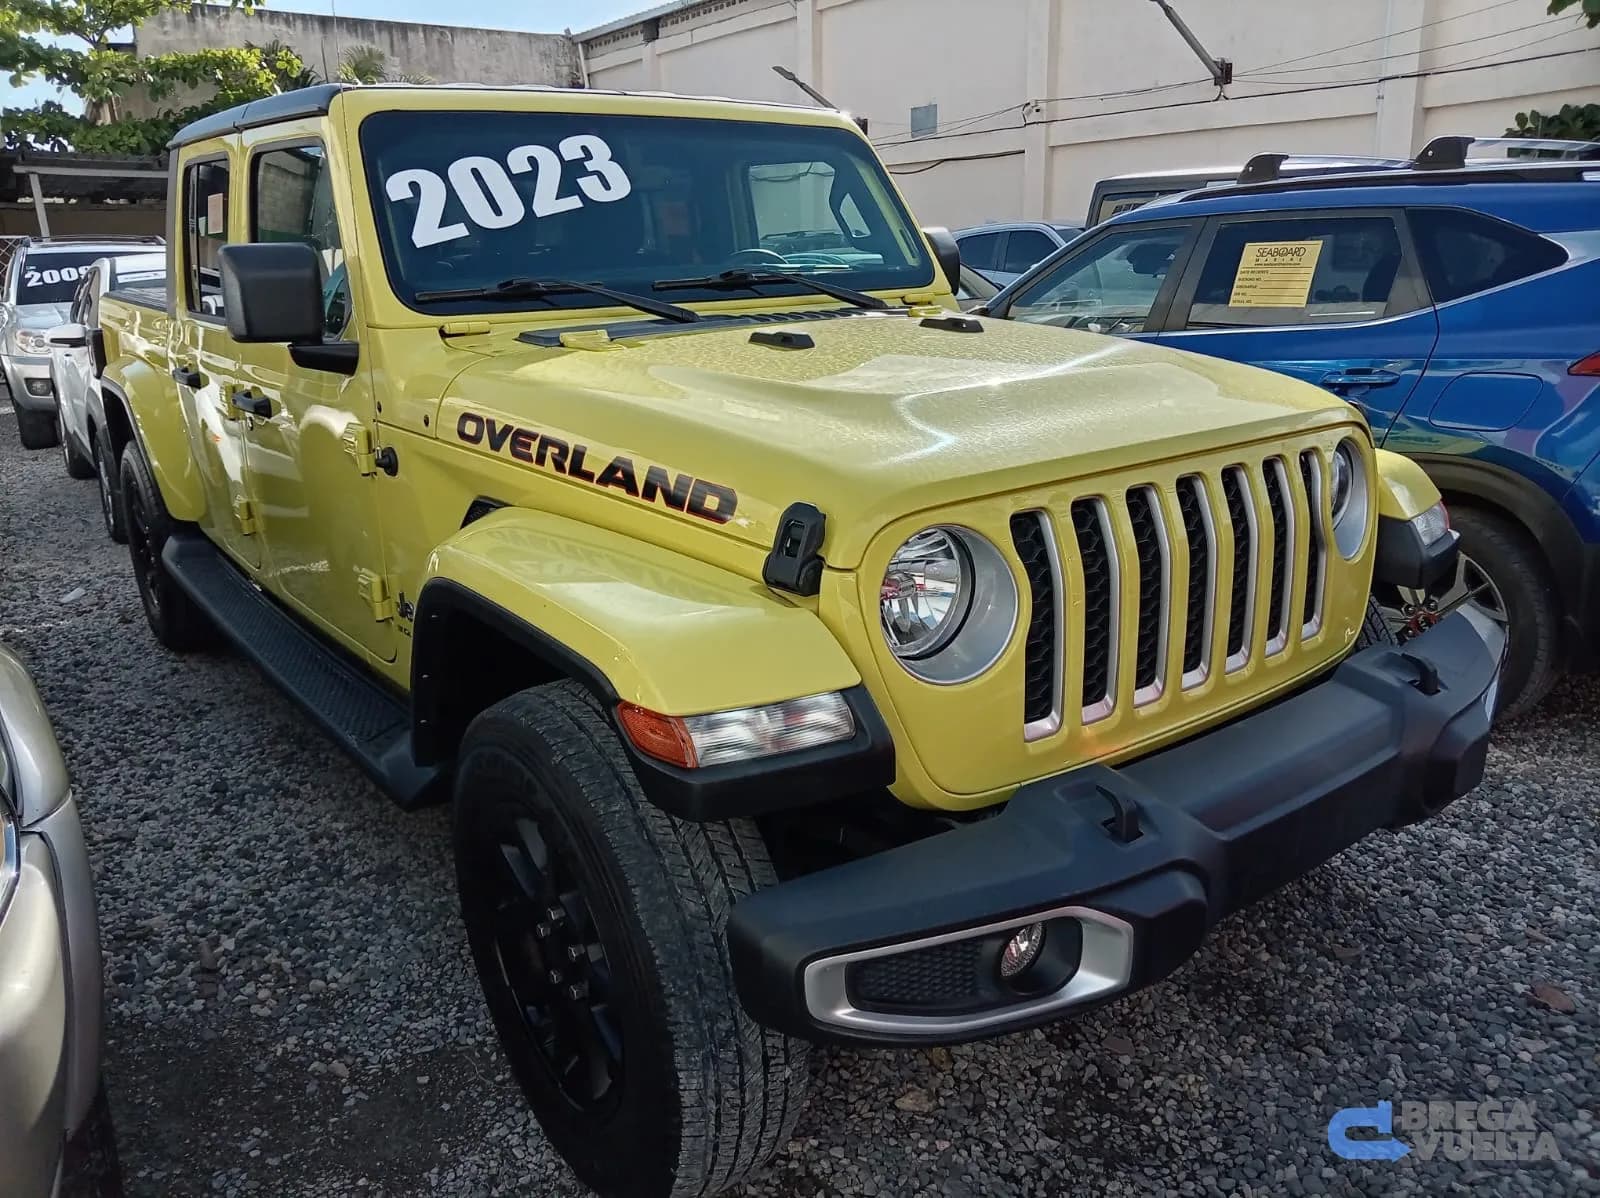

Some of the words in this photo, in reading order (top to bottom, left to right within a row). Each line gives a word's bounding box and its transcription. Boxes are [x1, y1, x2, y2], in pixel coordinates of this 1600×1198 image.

[385, 134, 632, 249] 2023
[1255, 247, 1306, 257] SEABOARD
[456, 411, 738, 525] OVERLAND
